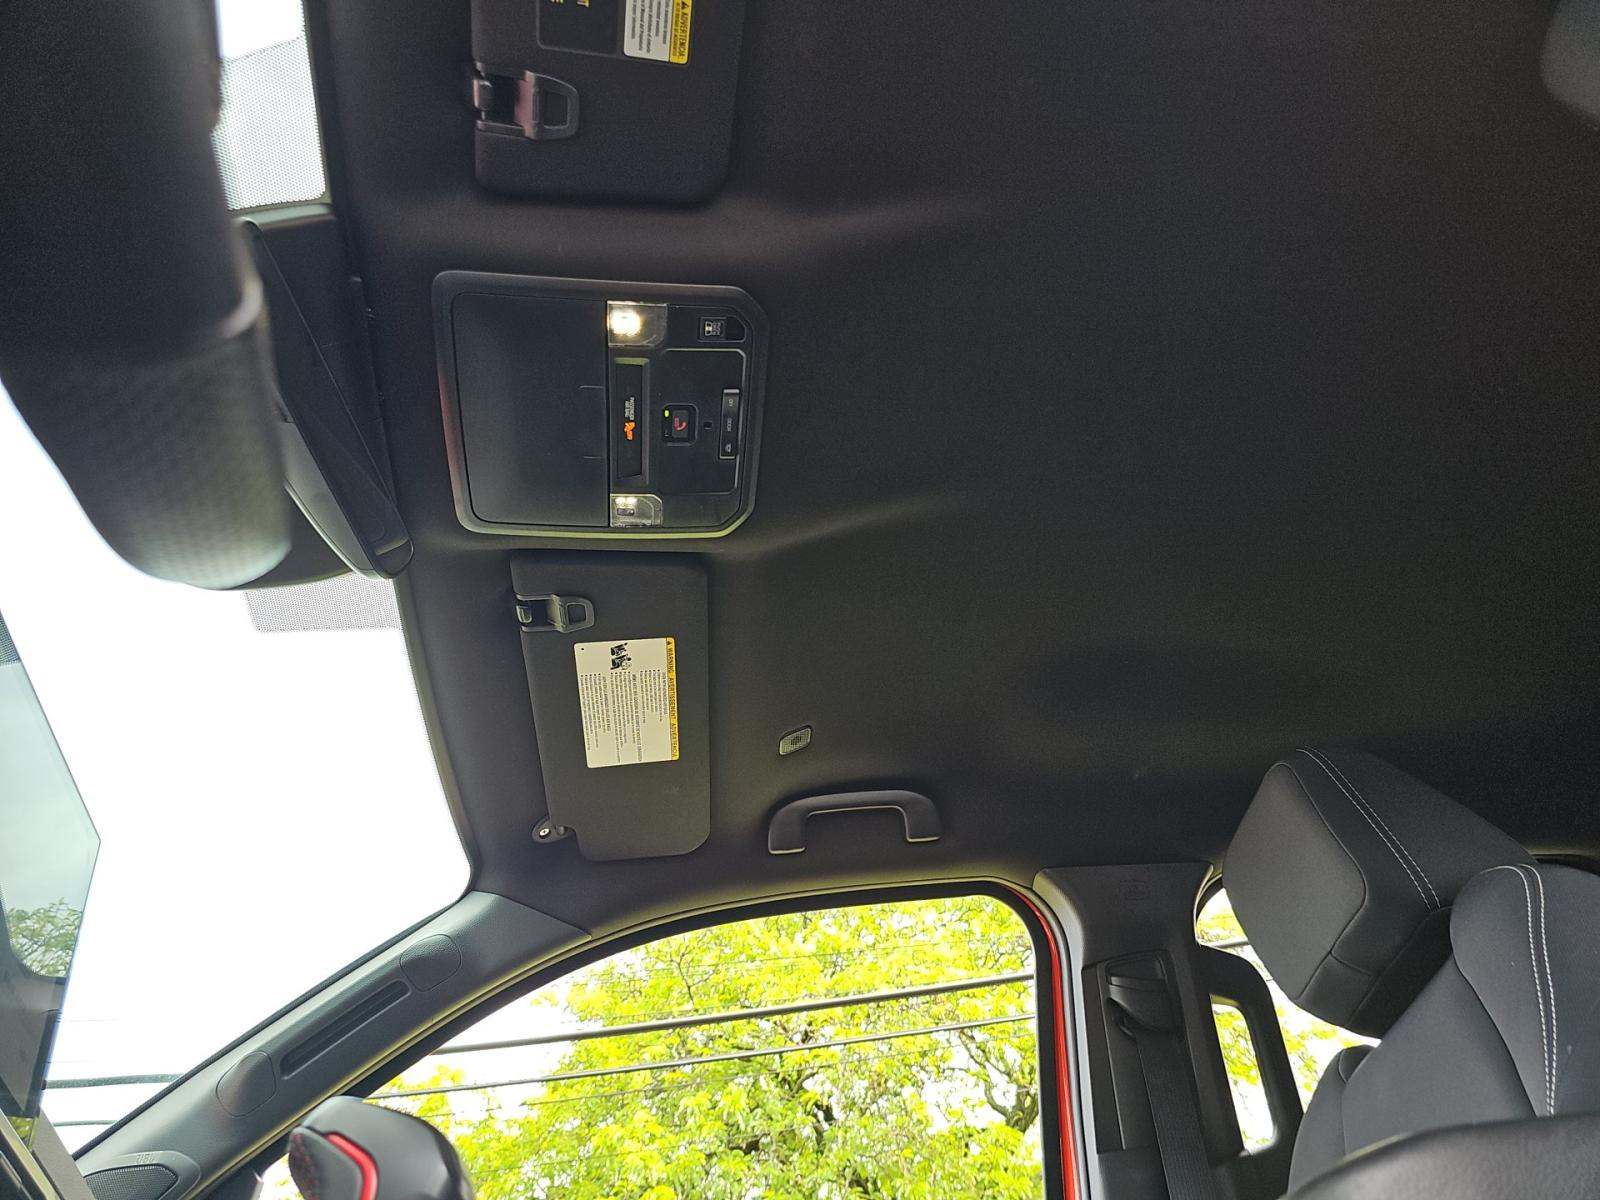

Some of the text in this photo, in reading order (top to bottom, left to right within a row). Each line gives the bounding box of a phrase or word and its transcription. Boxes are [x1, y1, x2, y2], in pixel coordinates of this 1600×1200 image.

[667, 647, 679, 758] WARNING AVERTISSEMENT ADVERTENCIA
